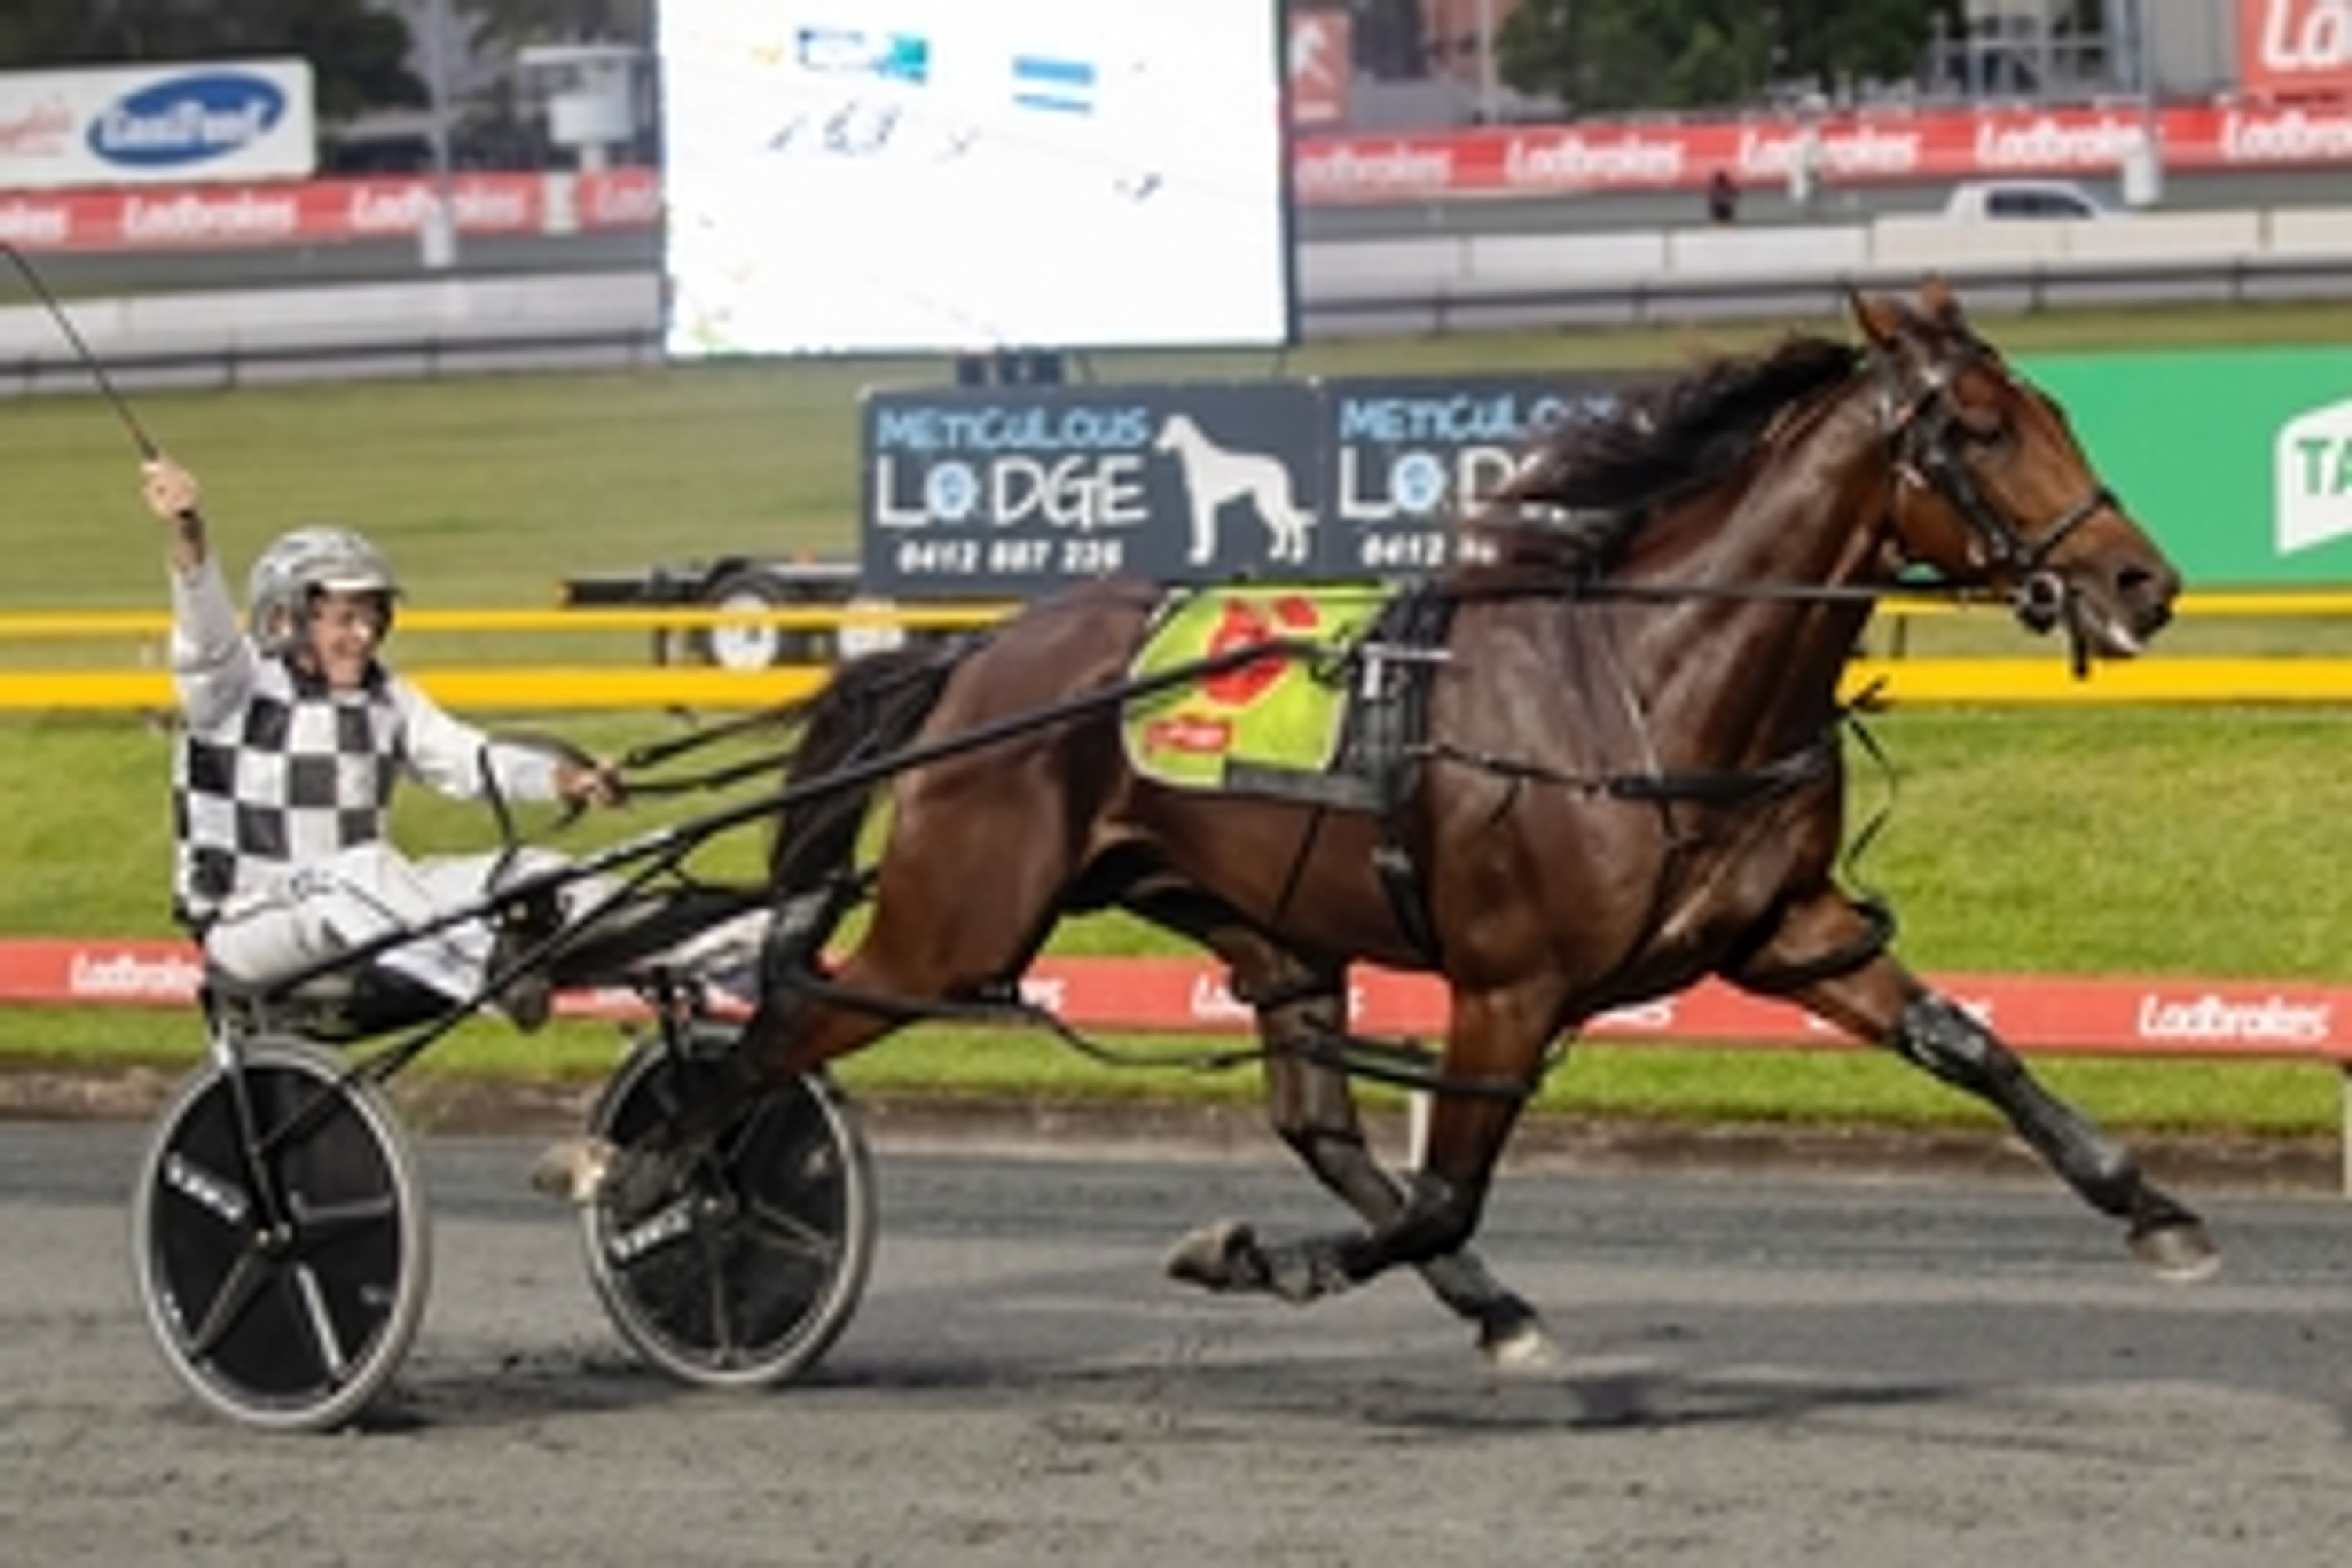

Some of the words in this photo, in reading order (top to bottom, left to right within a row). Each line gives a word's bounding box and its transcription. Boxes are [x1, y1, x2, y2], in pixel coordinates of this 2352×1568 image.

[877, 406, 1149, 448] METICULOUS
[877, 455, 1151, 530] LODGE
[2138, 994, 2332, 1041] Ladbrokes
